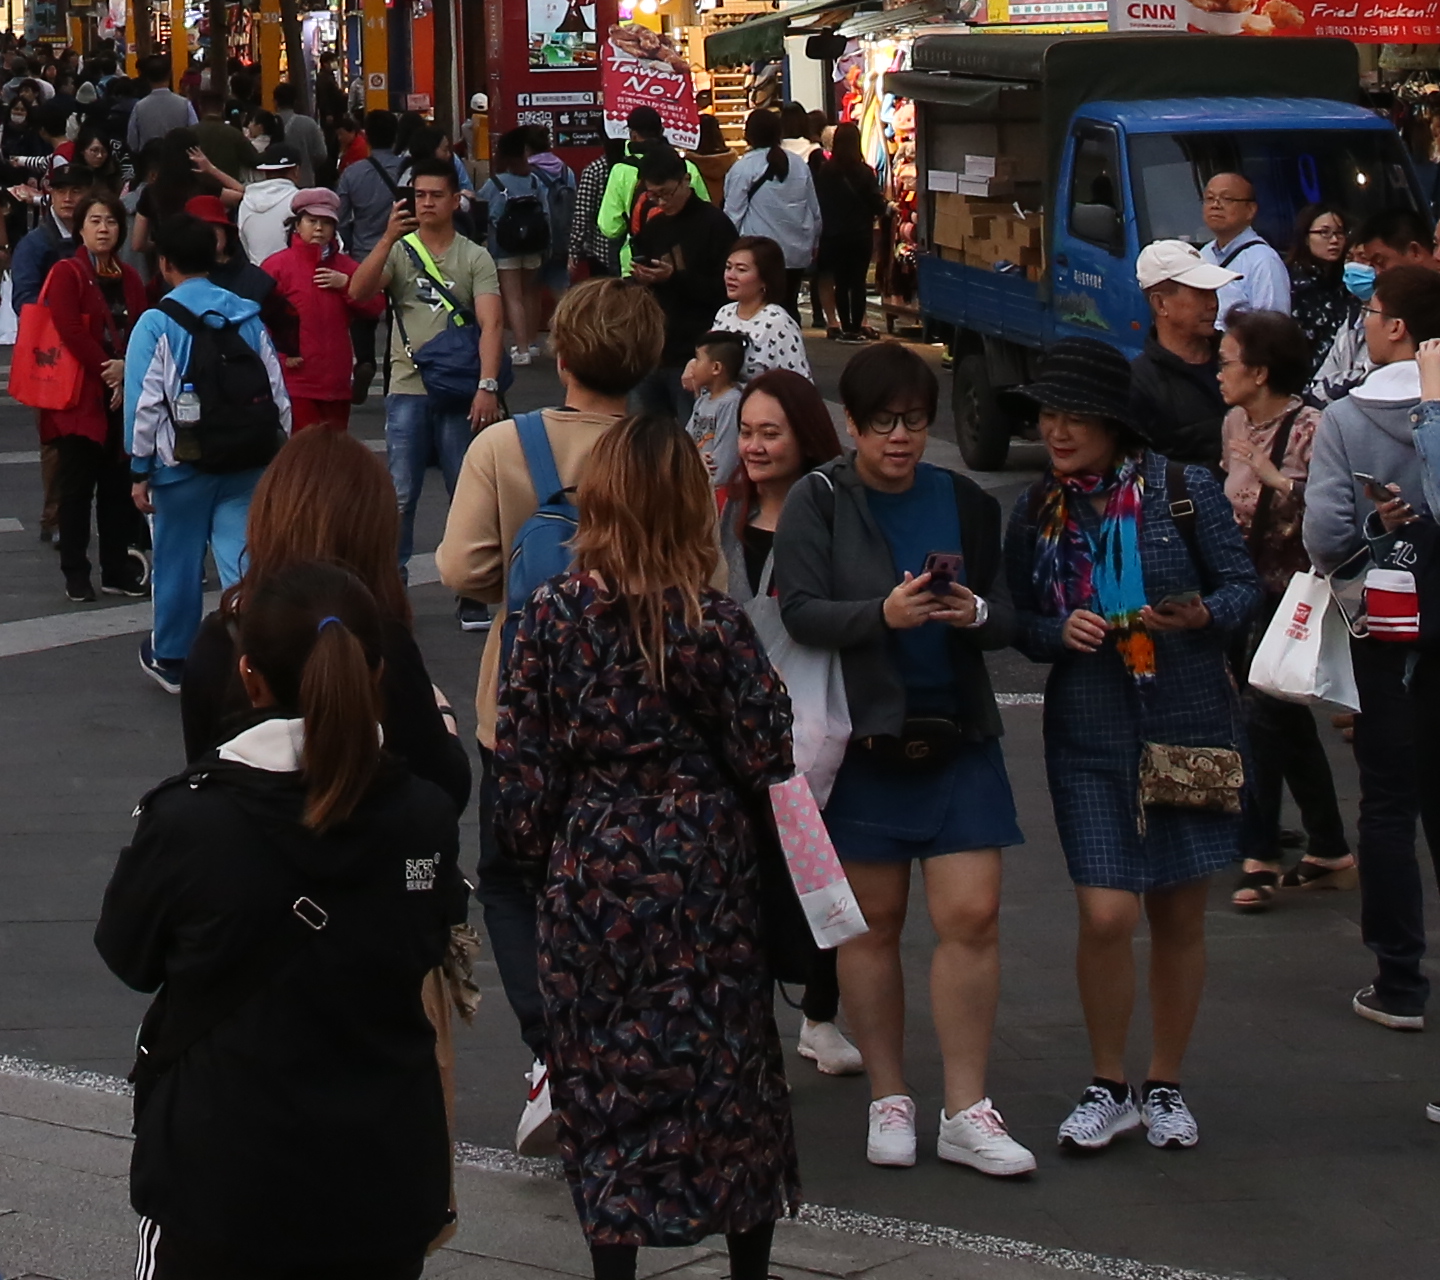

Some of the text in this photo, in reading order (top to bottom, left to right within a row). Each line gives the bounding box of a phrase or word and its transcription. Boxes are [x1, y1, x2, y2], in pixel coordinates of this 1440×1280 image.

[1127, 3, 1176, 20] CNN
[1311, 2, 1358, 18] Fried
[1363, 2, 1438, 18] chicken!!
[607, 57, 683, 83] Taiwan
[672, 132, 696, 144] CNN
